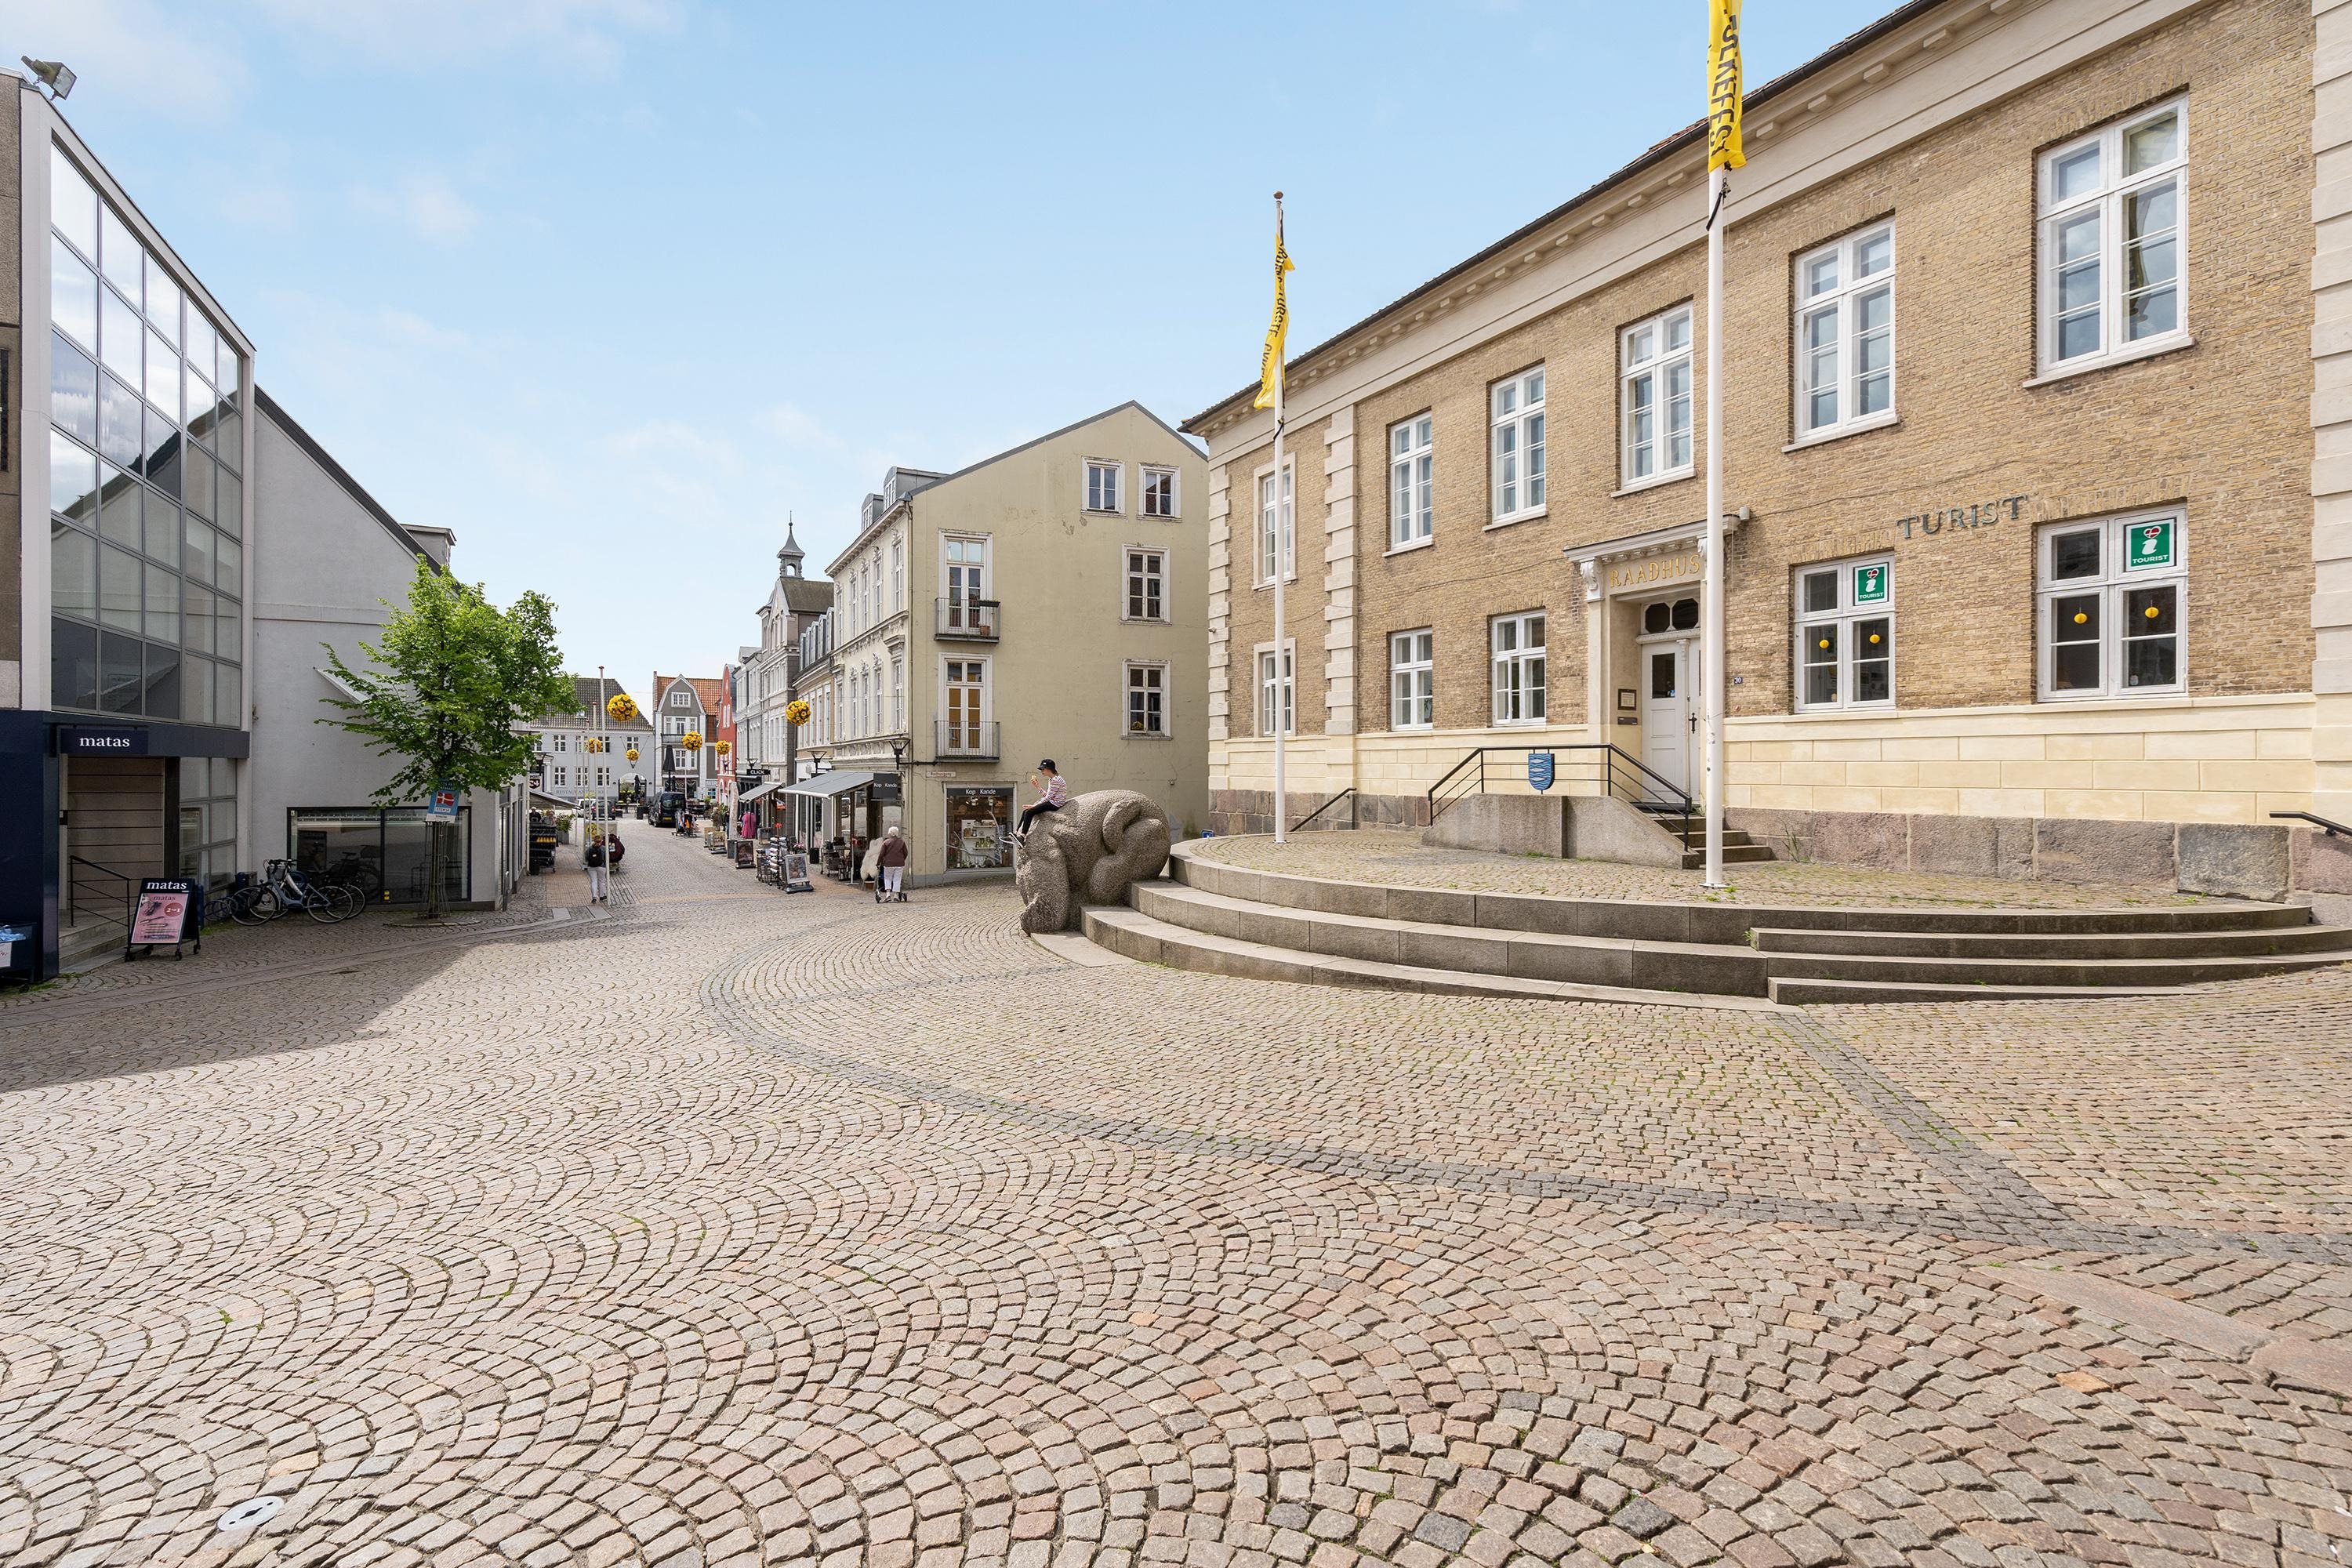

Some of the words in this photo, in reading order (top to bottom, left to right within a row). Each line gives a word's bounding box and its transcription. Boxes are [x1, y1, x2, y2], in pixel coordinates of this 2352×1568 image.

[1896, 493, 2028, 539] TURIST
[2132, 554, 2169, 564] TOURIST
[1610, 554, 1700, 587] RAADHUS
[79, 737, 130, 747] matas
[146, 881, 187, 890] matas
